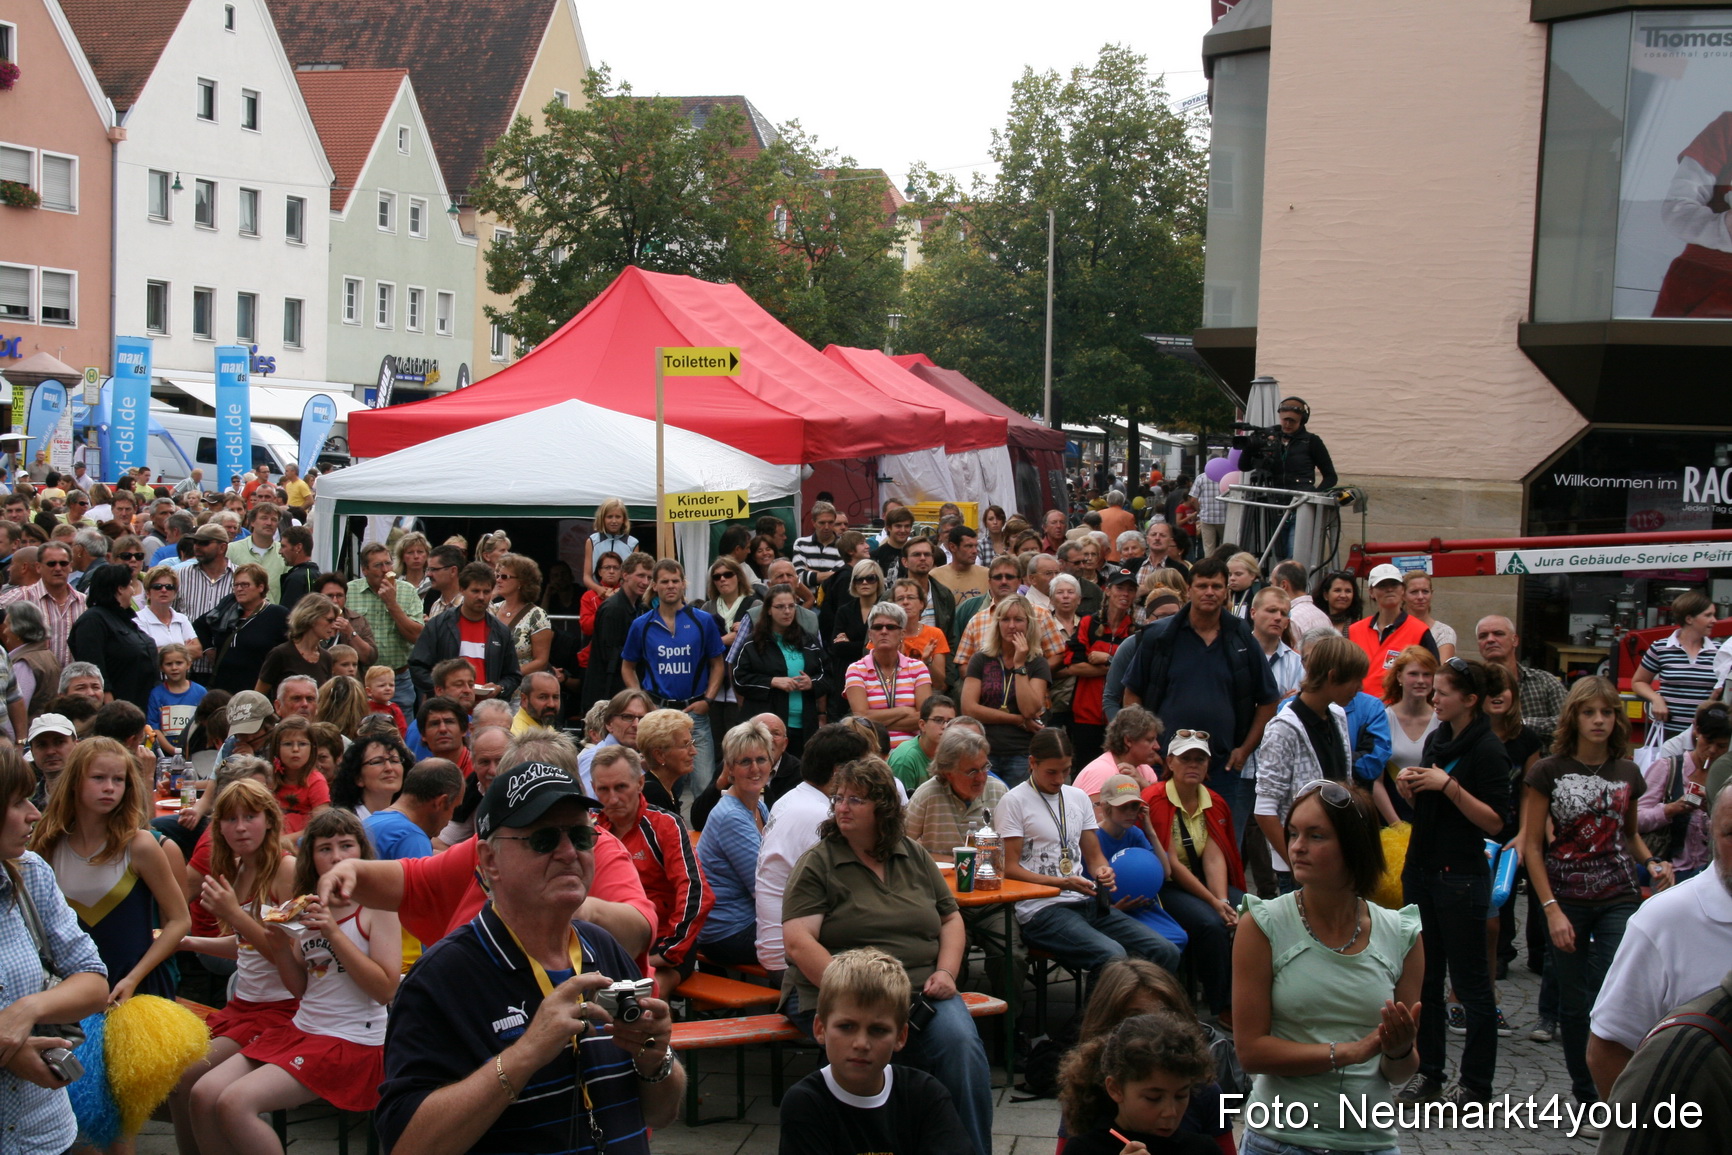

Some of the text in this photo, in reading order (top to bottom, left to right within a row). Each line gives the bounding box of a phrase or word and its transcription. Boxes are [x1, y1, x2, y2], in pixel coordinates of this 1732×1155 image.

[118, 352, 144, 365] maxi
[249, 344, 276, 373] ies
[664, 355, 726, 368] Toiletten
[134, 365, 146, 375] dsl
[221, 361, 245, 374] maxi
[237, 373, 247, 382] dsl
[1554, 474, 1653, 489] Willkommen
[1657, 477, 1677, 490] im
[678, 494, 724, 506] Kinder-
[669, 508, 734, 519] betreuung
[1682, 504, 1709, 512] Jeden
[1711, 505, 1727, 515] Tag
[1535, 556, 1564, 568] Jura
[1569, 552, 1688, 566] Gebäude-Service
[657, 644, 691, 659] Sport
[658, 662, 691, 675] PAULI
[507, 770, 533, 798] Las
[492, 1013, 525, 1033] PUMA
